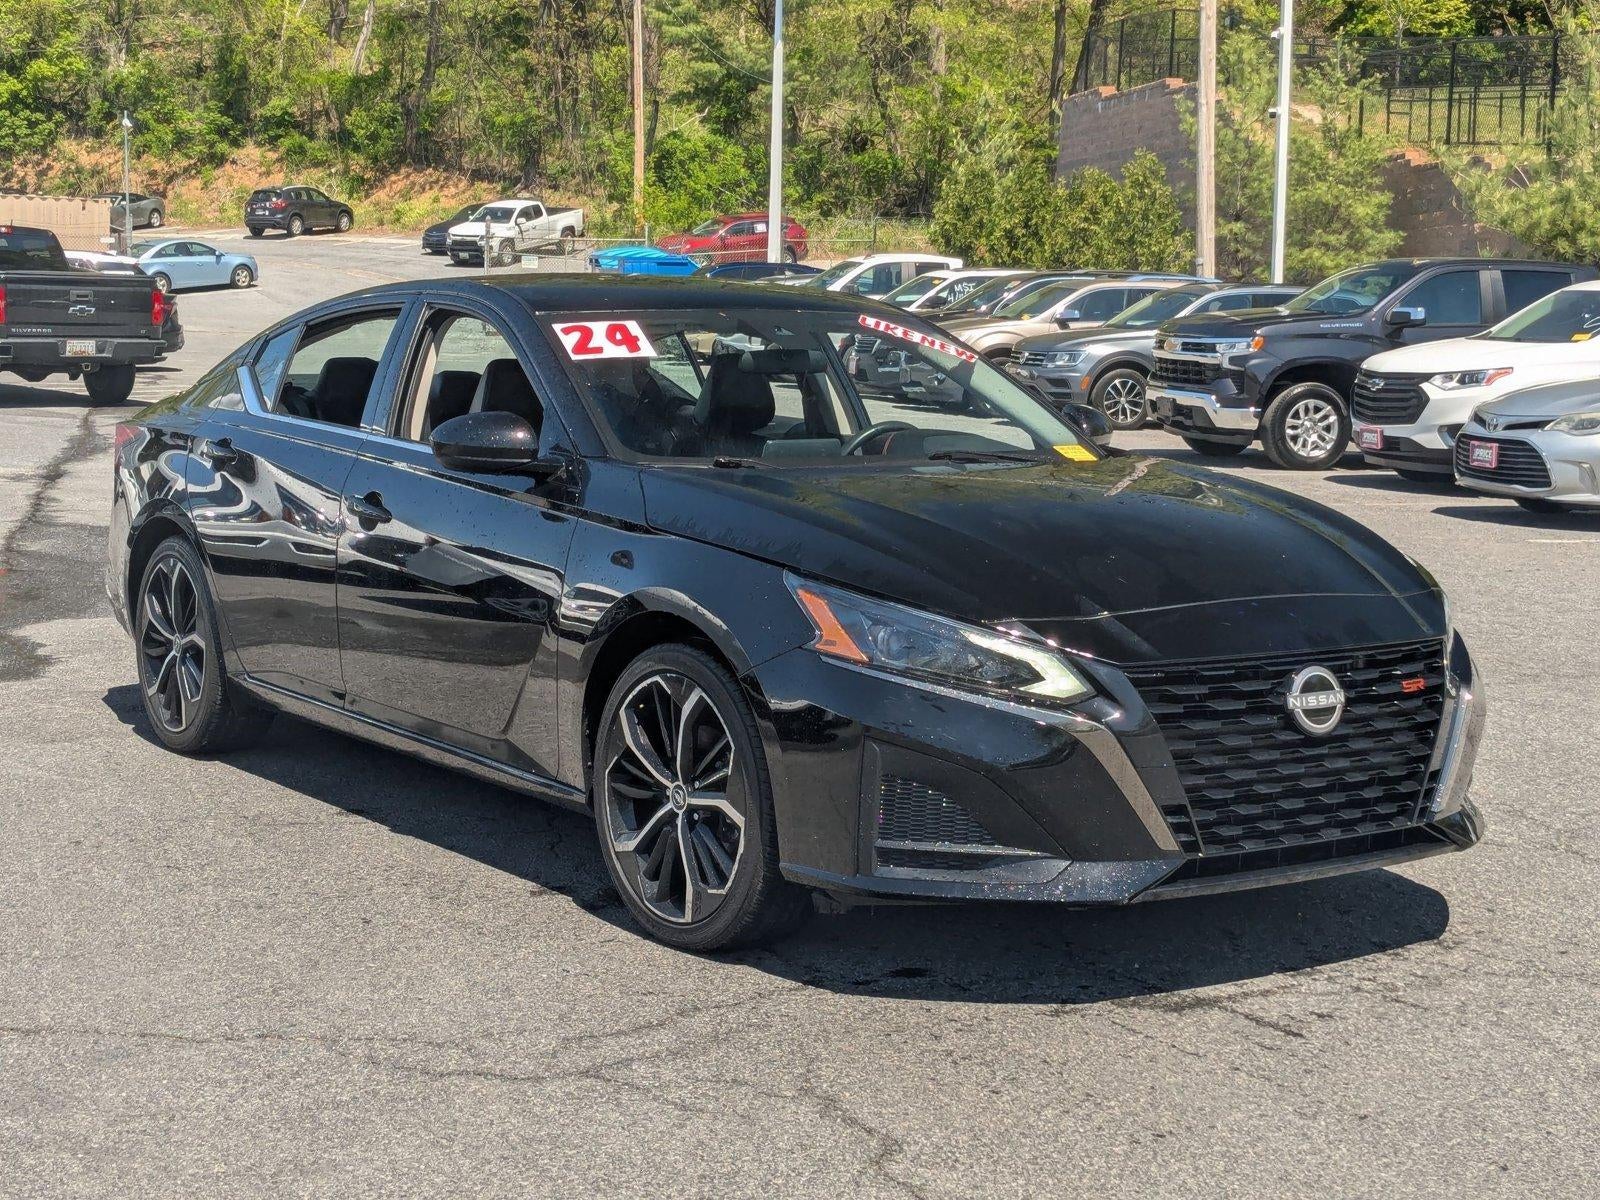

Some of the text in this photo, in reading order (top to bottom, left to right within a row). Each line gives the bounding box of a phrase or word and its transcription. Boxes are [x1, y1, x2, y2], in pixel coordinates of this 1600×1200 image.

[560, 323, 641, 355] 24
[1402, 679, 1424, 692] SR
[1289, 692, 1345, 708] NISSAN
